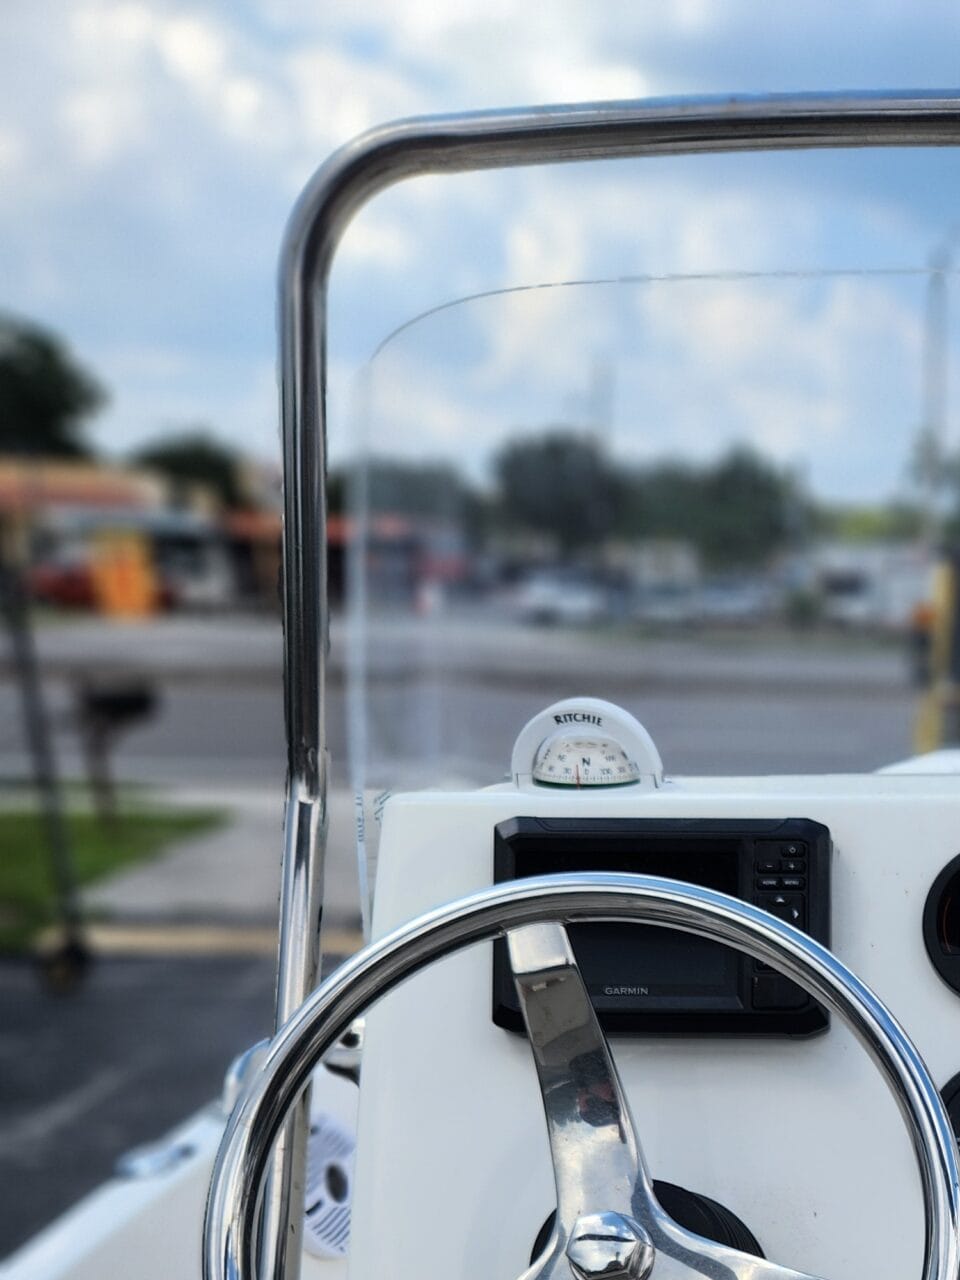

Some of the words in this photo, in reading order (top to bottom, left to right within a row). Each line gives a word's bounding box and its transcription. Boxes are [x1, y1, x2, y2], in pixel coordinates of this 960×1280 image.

[554, 713, 602, 727] RITCHIE
[582, 757, 590, 767] N
[604, 987, 649, 995] GARMIN
